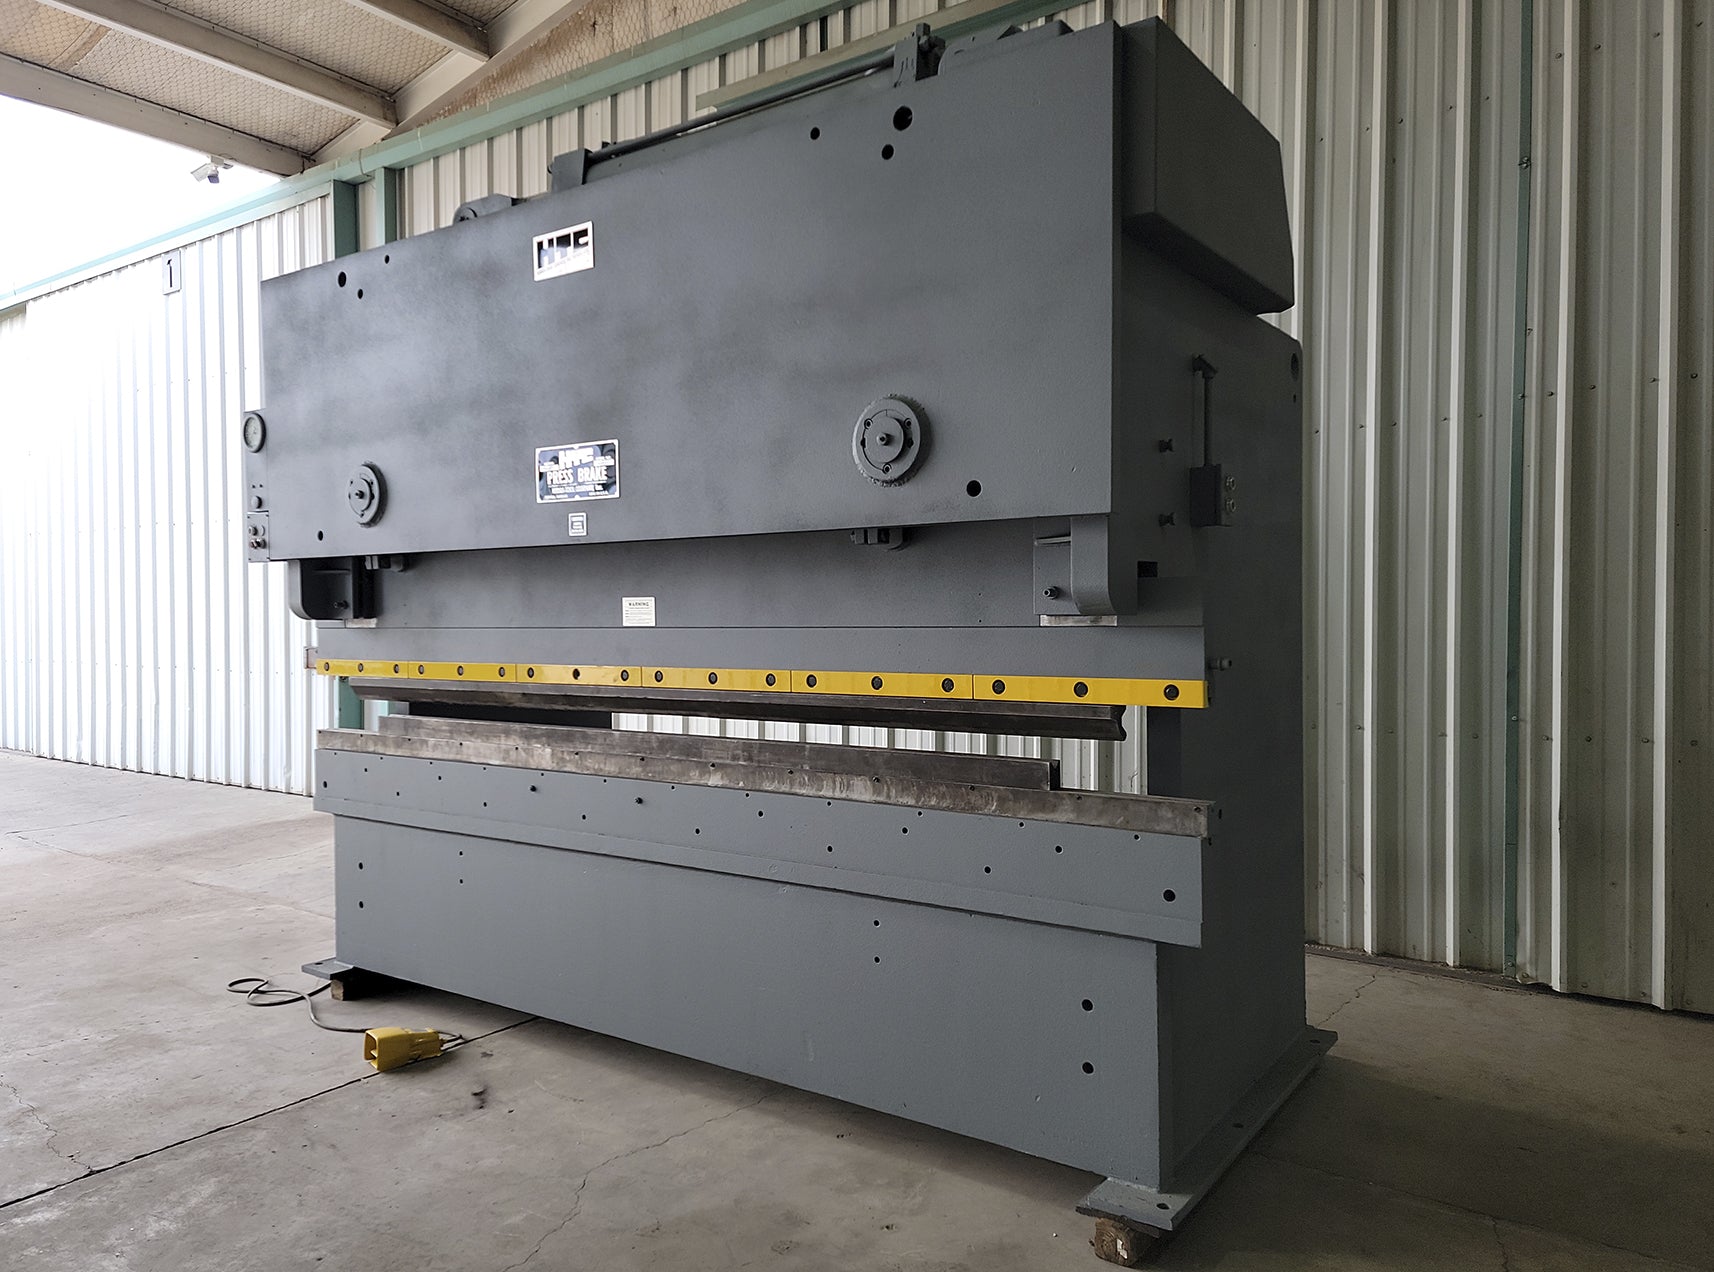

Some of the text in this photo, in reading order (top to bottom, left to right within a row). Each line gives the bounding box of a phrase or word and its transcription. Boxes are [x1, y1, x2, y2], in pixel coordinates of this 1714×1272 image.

[166, 258, 173, 288] 1
[546, 469, 574, 485] PRESS
[577, 466, 608, 482] BRAKE
